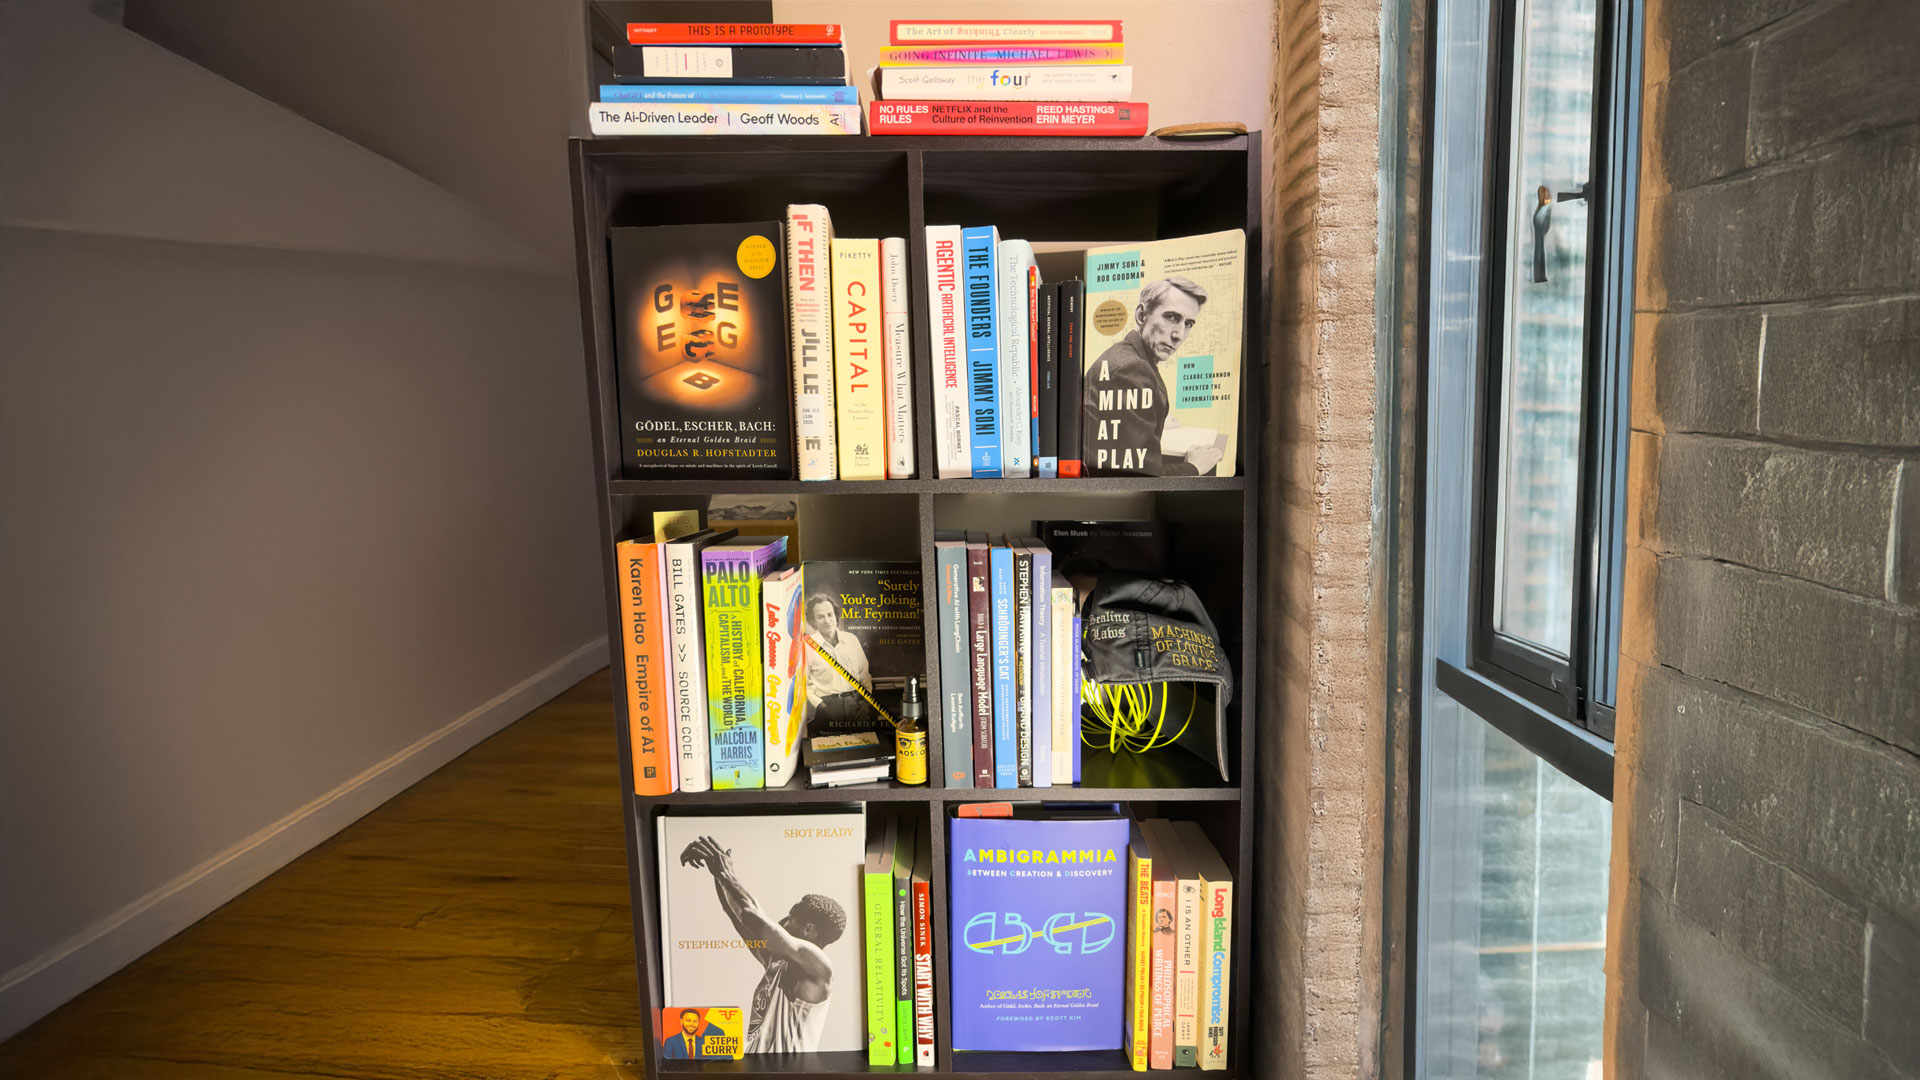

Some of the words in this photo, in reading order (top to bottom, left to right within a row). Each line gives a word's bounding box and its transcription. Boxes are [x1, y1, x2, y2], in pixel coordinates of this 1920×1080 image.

[688, 25, 710, 36] THIS
[715, 25, 725, 35] IS
[729, 25, 736, 35] A
[739, 25, 795, 36] PROTOTYPE
[889, 51, 929, 60] GOING
[934, 51, 987, 60] INFINITE
[996, 48, 1051, 60] MICHAEL
[1057, 48, 1096, 59] LEWIS
[967, 74, 985, 84] the
[990, 69, 1031, 86] four
[599, 111, 620, 122] The
[624, 111, 675, 123] Ai-Driven
[678, 112, 718, 123] Leader
[740, 113, 774, 125] Geoff
[778, 114, 819, 125] Woods
[880, 105, 894, 113] NO
[897, 105, 929, 113] RULES
[880, 115, 912, 124] RULES
[932, 105, 971, 113] NETFLIX
[974, 105, 991, 113] and
[993, 105, 1008, 113] the
[932, 115, 965, 124] Culture
[967, 115, 976, 124] of
[979, 115, 1032, 124] Reinvention
[1036, 115, 1059, 124] ERIN
[1061, 115, 1095, 124] MEYER
[1037, 105, 1063, 113] REED
[1065, 105, 1115, 114] HASTINGS
[792, 214, 813, 234] IF
[798, 239, 816, 292] THEN
[839, 252, 872, 260] PIKETTY
[936, 240, 955, 291] AGENTIC
[968, 246, 989, 270] THE
[1009, 255, 1018, 273] The
[1097, 262, 1119, 271] JIMMY
[1122, 260, 1138, 269] SONI
[1097, 274, 1109, 282] ROB
[1112, 272, 1145, 281] GOODMAN
[941, 293, 954, 336] ARTIFICIAL
[969, 275, 992, 339] FOUNDERS
[1008, 275, 1020, 337] Technological
[846, 280, 869, 394] CAPITAL
[943, 337, 957, 388] INTELLIGENCE
[1009, 339, 1020, 378] Republic
[973, 360, 993, 403] JIMMY
[1099, 360, 1110, 382] A
[1099, 388, 1153, 411] MIND
[635, 420, 682, 433] GÖDEL,
[684, 421, 737, 433] ESCHER,
[739, 421, 776, 431] BACH:
[974, 408, 995, 436] SONI
[1097, 419, 1121, 441] AT
[637, 449, 689, 457] DOUGLAS
[693, 449, 703, 457] R.
[706, 449, 777, 457] HOFSTADTER
[1097, 448, 1147, 470] PLAY
[629, 558, 643, 607] Karen
[672, 559, 683, 590] BILL
[706, 561, 750, 584] PALO
[708, 585, 751, 608] ALTO
[674, 594, 686, 635] GATES
[1089, 611, 1131, 626] Scaling
[633, 612, 646, 645] Hao
[997, 598, 1010, 664] SCHRÖDINGER'S
[1091, 626, 1126, 641] Laws
[1150, 624, 1215, 649] MACHINES
[718, 613, 731, 667] CAPITALISM,
[731, 620, 744, 660] HISTORY
[974, 630, 987, 652] Large
[1155, 639, 1173, 653] OF
[721, 667, 729, 680] and
[733, 660, 740, 668] of
[975, 653, 989, 690] Language
[999, 665, 1009, 680] CAT
[635, 654, 652, 711] Empire
[722, 679, 731, 695] THE
[678, 671, 691, 722] SOURCE
[734, 668, 747, 725] CALIFORNIA,
[978, 691, 990, 716] Model
[723, 696, 734, 727] WORLD
[640, 716, 653, 733] of
[642, 736, 655, 754] AI
[681, 726, 693, 760] CODE
[784, 828, 814, 838] SHOT
[816, 828, 854, 838] READY
[963, 848, 1117, 864] AMBIGRAMMIA
[967, 869, 1007, 877] BETWEEN
[1009, 869, 1053, 877] CREATION
[1065, 869, 1113, 877] DISCOVERY
[1185, 906, 1192, 915] IS
[1211, 888, 1228, 918] Long
[874, 903, 882, 954] GENERAL
[1185, 917, 1192, 930] AN
[1213, 917, 1227, 952] Island
[679, 941, 728, 949] STEPHEN
[730, 940, 768, 949] CURRY
[916, 953, 933, 986] START
[875, 958, 884, 1023] RELATIVITY
[1210, 952, 1225, 1024] Compromise
[918, 988, 933, 1011] WITH
[918, 1014, 934, 1040] WHY
[705, 1045, 738, 1054] CURRY
[710, 1037, 738, 1045] STEPH
